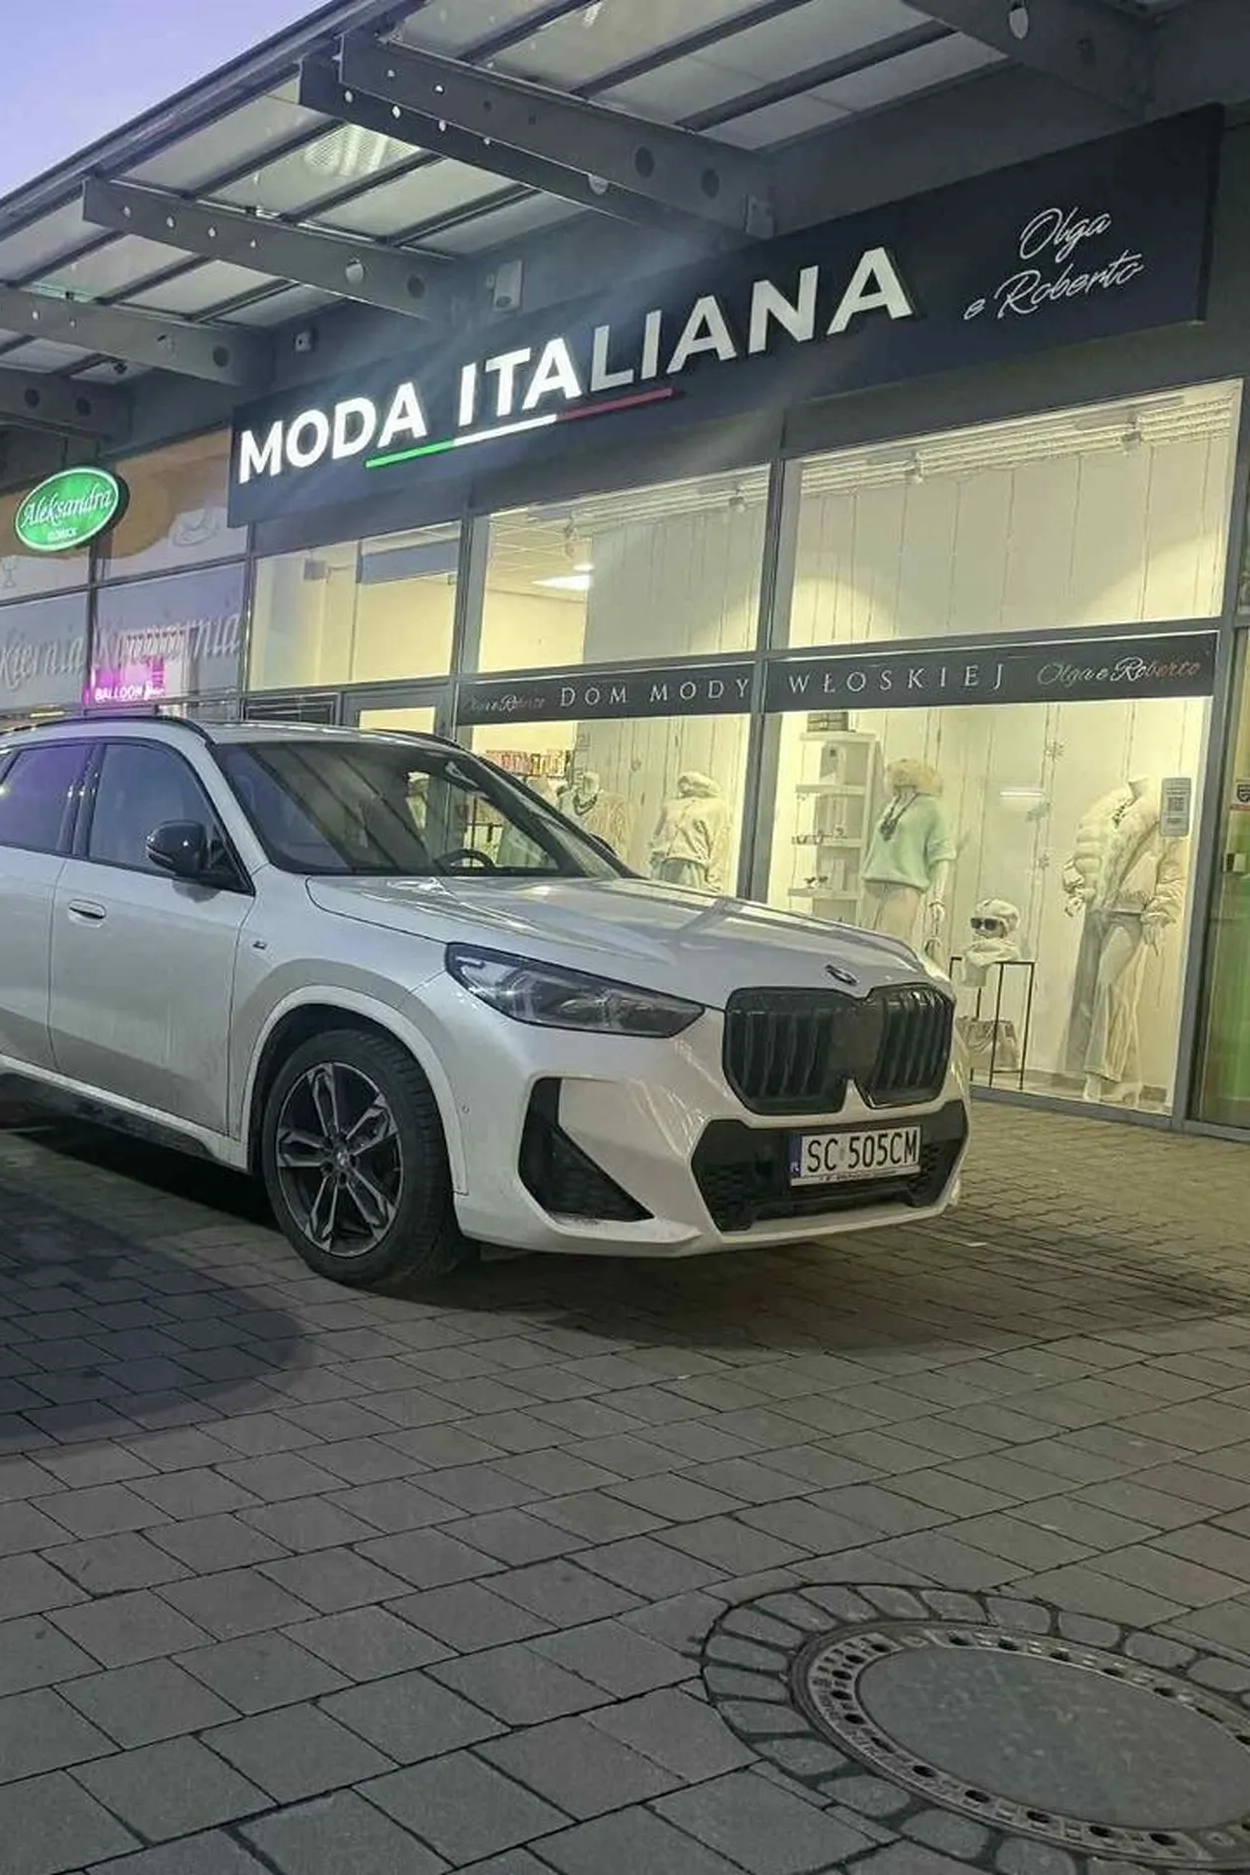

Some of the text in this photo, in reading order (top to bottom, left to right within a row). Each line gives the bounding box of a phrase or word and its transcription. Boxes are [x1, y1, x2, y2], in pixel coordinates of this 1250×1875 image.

[1019, 206, 1112, 264] Olga
[963, 249, 1146, 320] e Roberto
[239, 245, 915, 484] MODA ITALIANA
[20, 483, 112, 528] Aleksandra
[559, 685, 628, 708] DOM
[649, 677, 750, 702] MODY
[788, 662, 1004, 694] WŁOSKIEJ
[1110, 655, 1201, 682] Roberto
[94, 684, 143, 703] BALLOON
[806, 1137, 839, 1173] SC
[847, 1129, 918, 1169] 505CM
